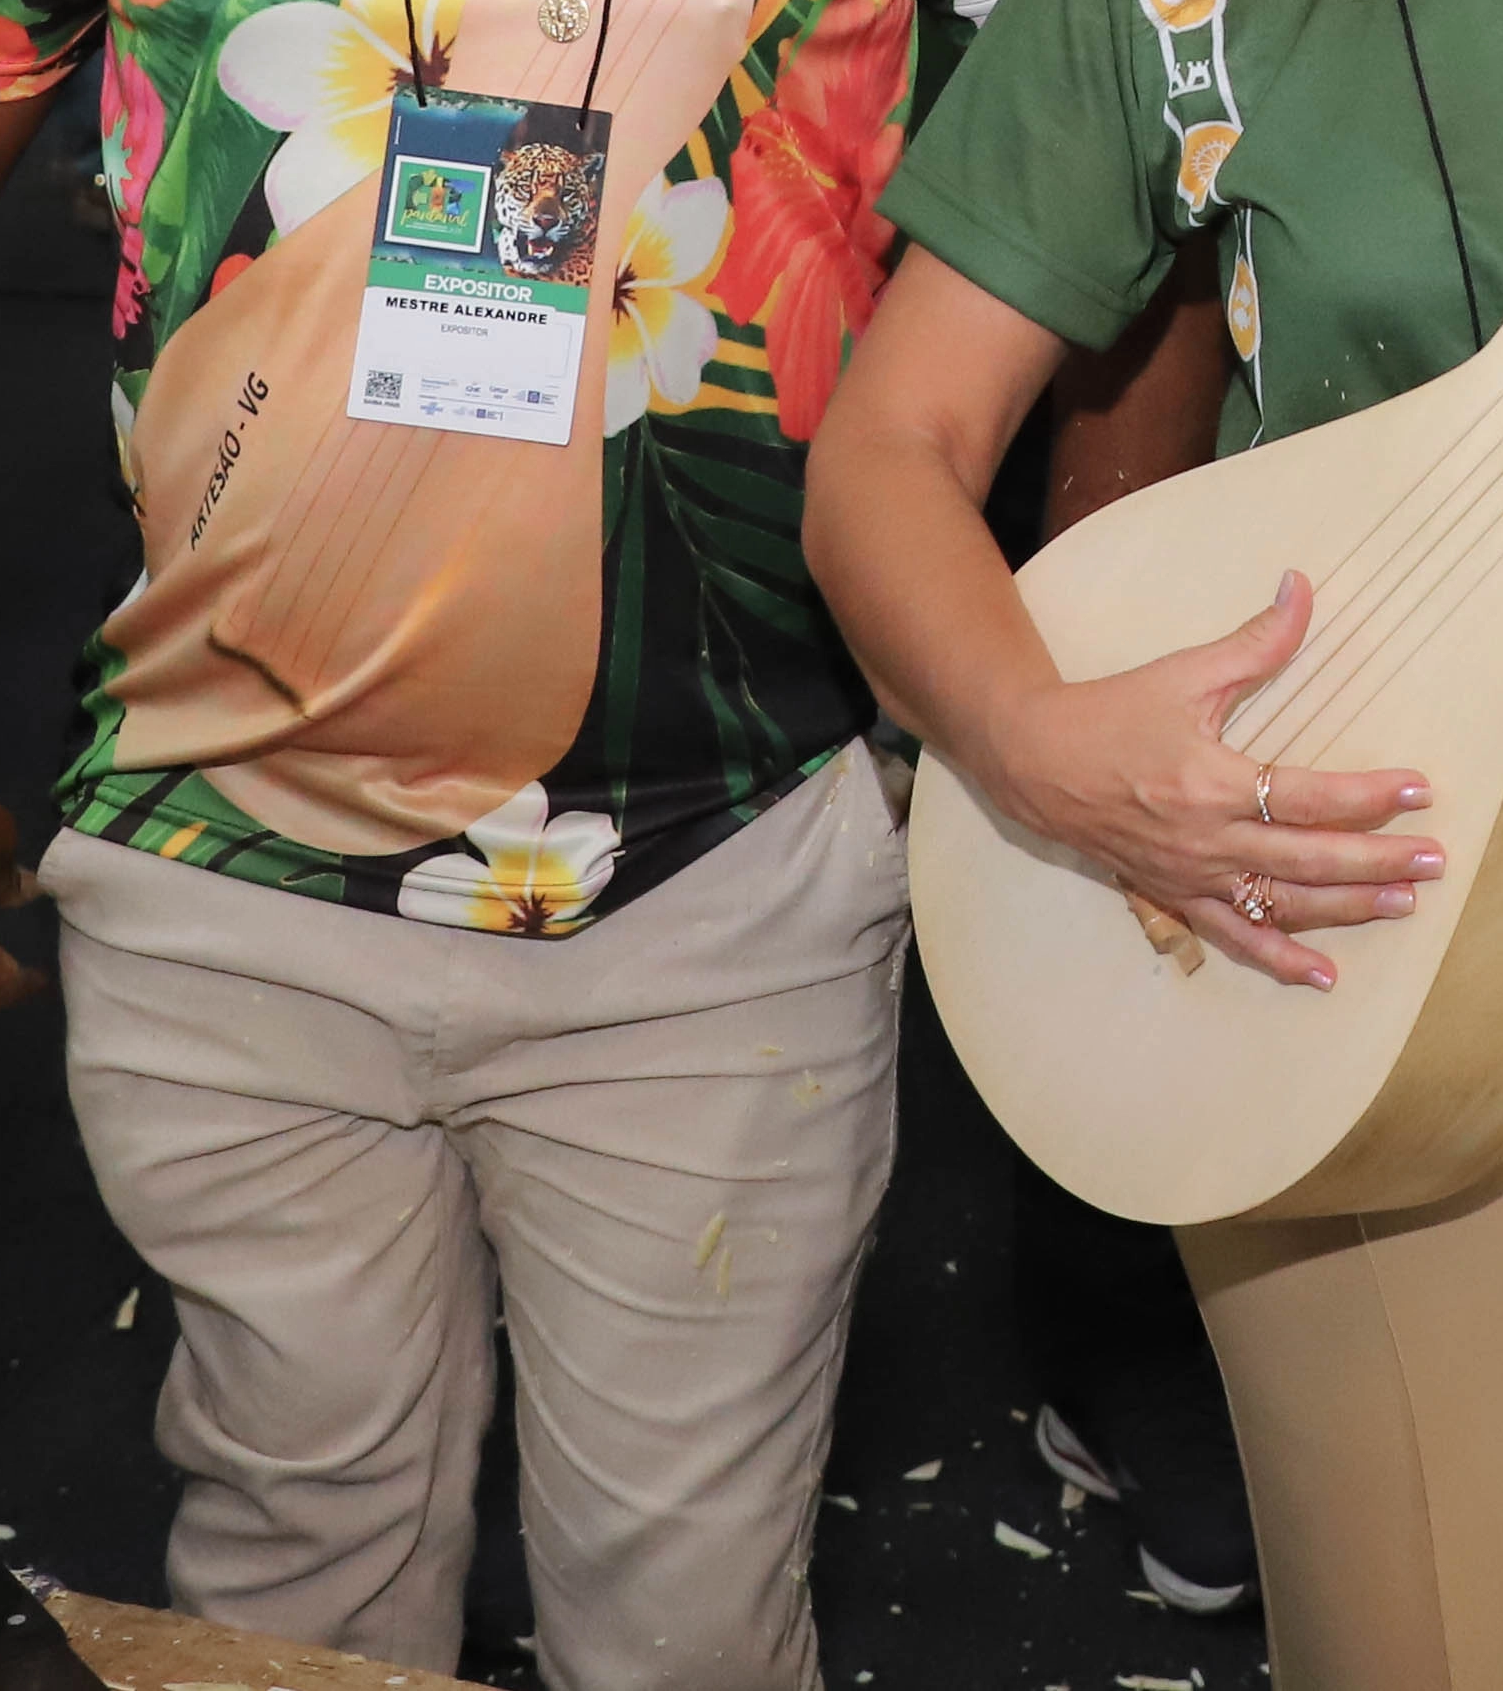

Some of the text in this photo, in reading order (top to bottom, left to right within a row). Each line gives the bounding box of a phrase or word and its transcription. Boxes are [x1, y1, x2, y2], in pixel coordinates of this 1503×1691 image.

[424, 273, 533, 303] EXPOSITOR
[386, 295, 548, 326] MESTRE ALEXANDRE
[441, 323, 489, 337] EXPOSITOR
[190, 429, 241, 552] ARTESÃO
[237, 371, 269, 416] VG
